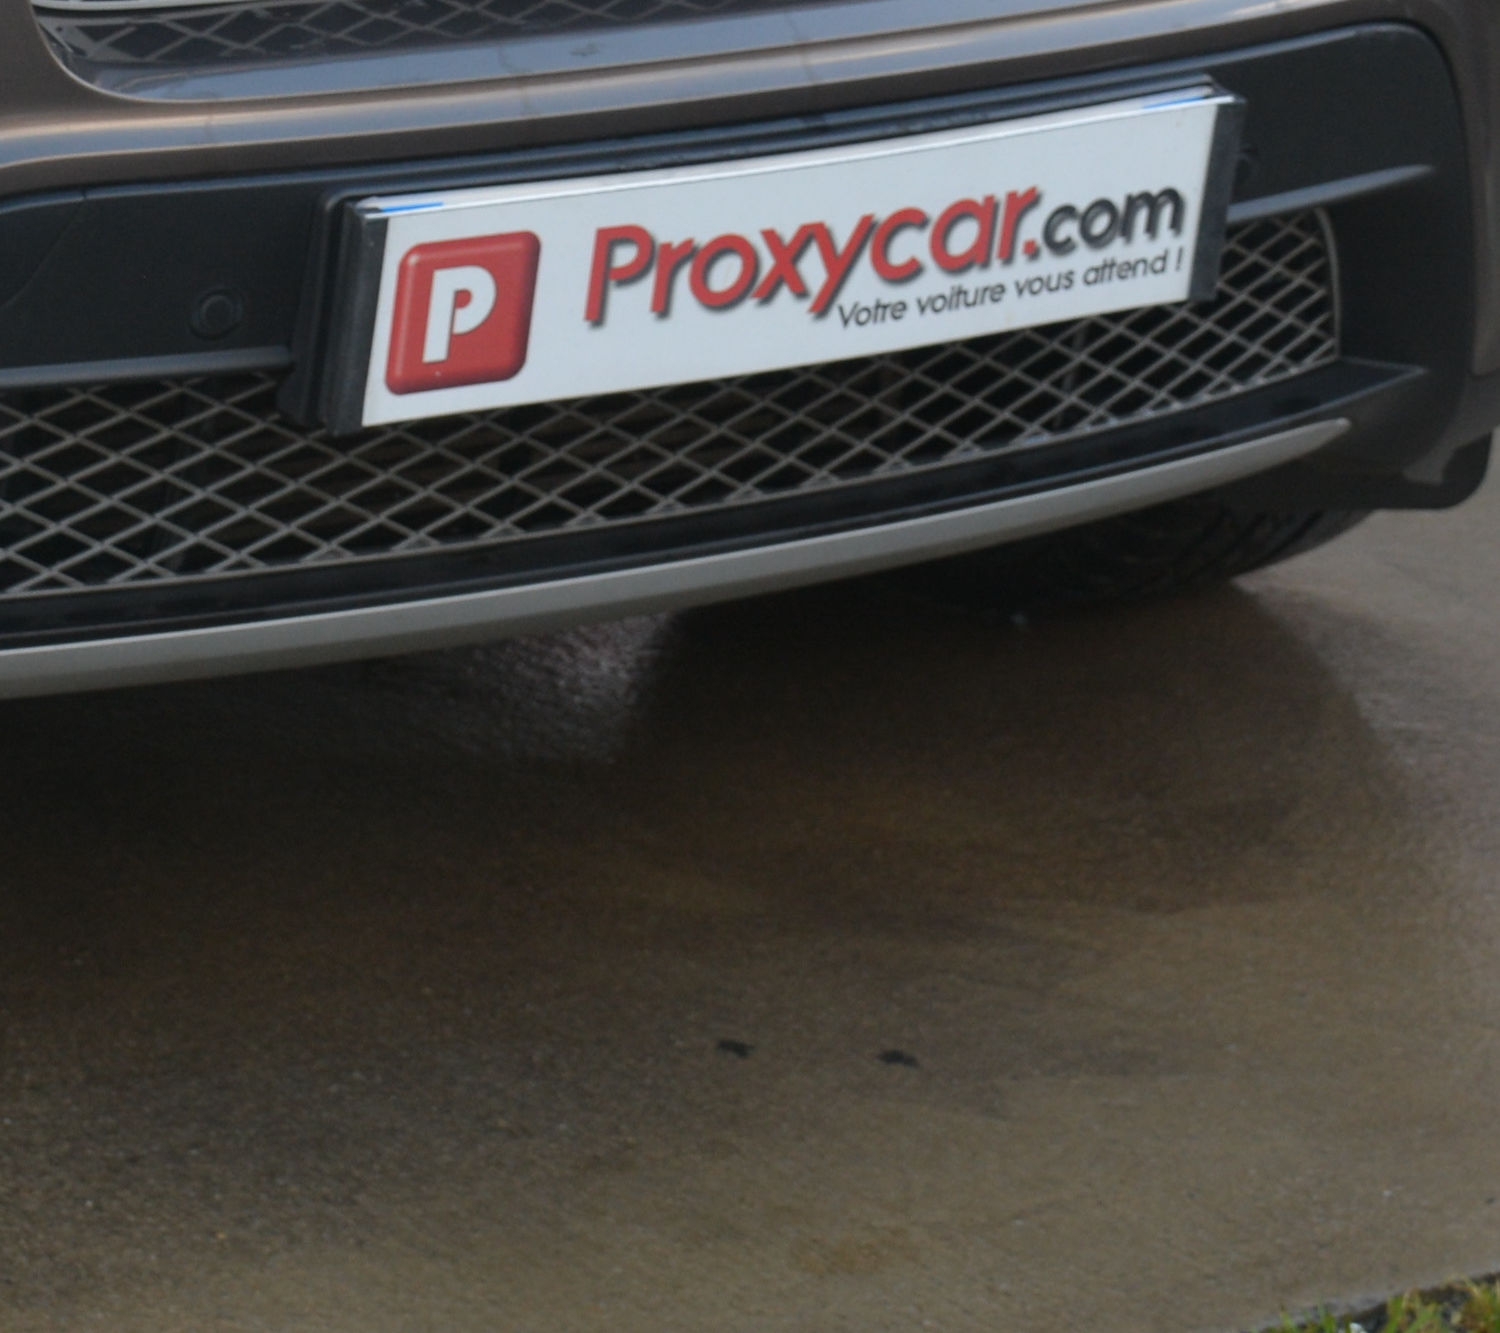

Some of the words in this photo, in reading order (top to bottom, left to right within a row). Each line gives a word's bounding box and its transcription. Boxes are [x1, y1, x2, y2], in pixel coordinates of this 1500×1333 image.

[583, 185, 1185, 327] Proxycar.com
[838, 299, 908, 328] Votre
[917, 284, 1005, 316] voiture
[1014, 270, 1075, 295] vous
[1082, 250, 1168, 286] attend
[1174, 246, 1185, 272] !
[421, 264, 498, 366] P
